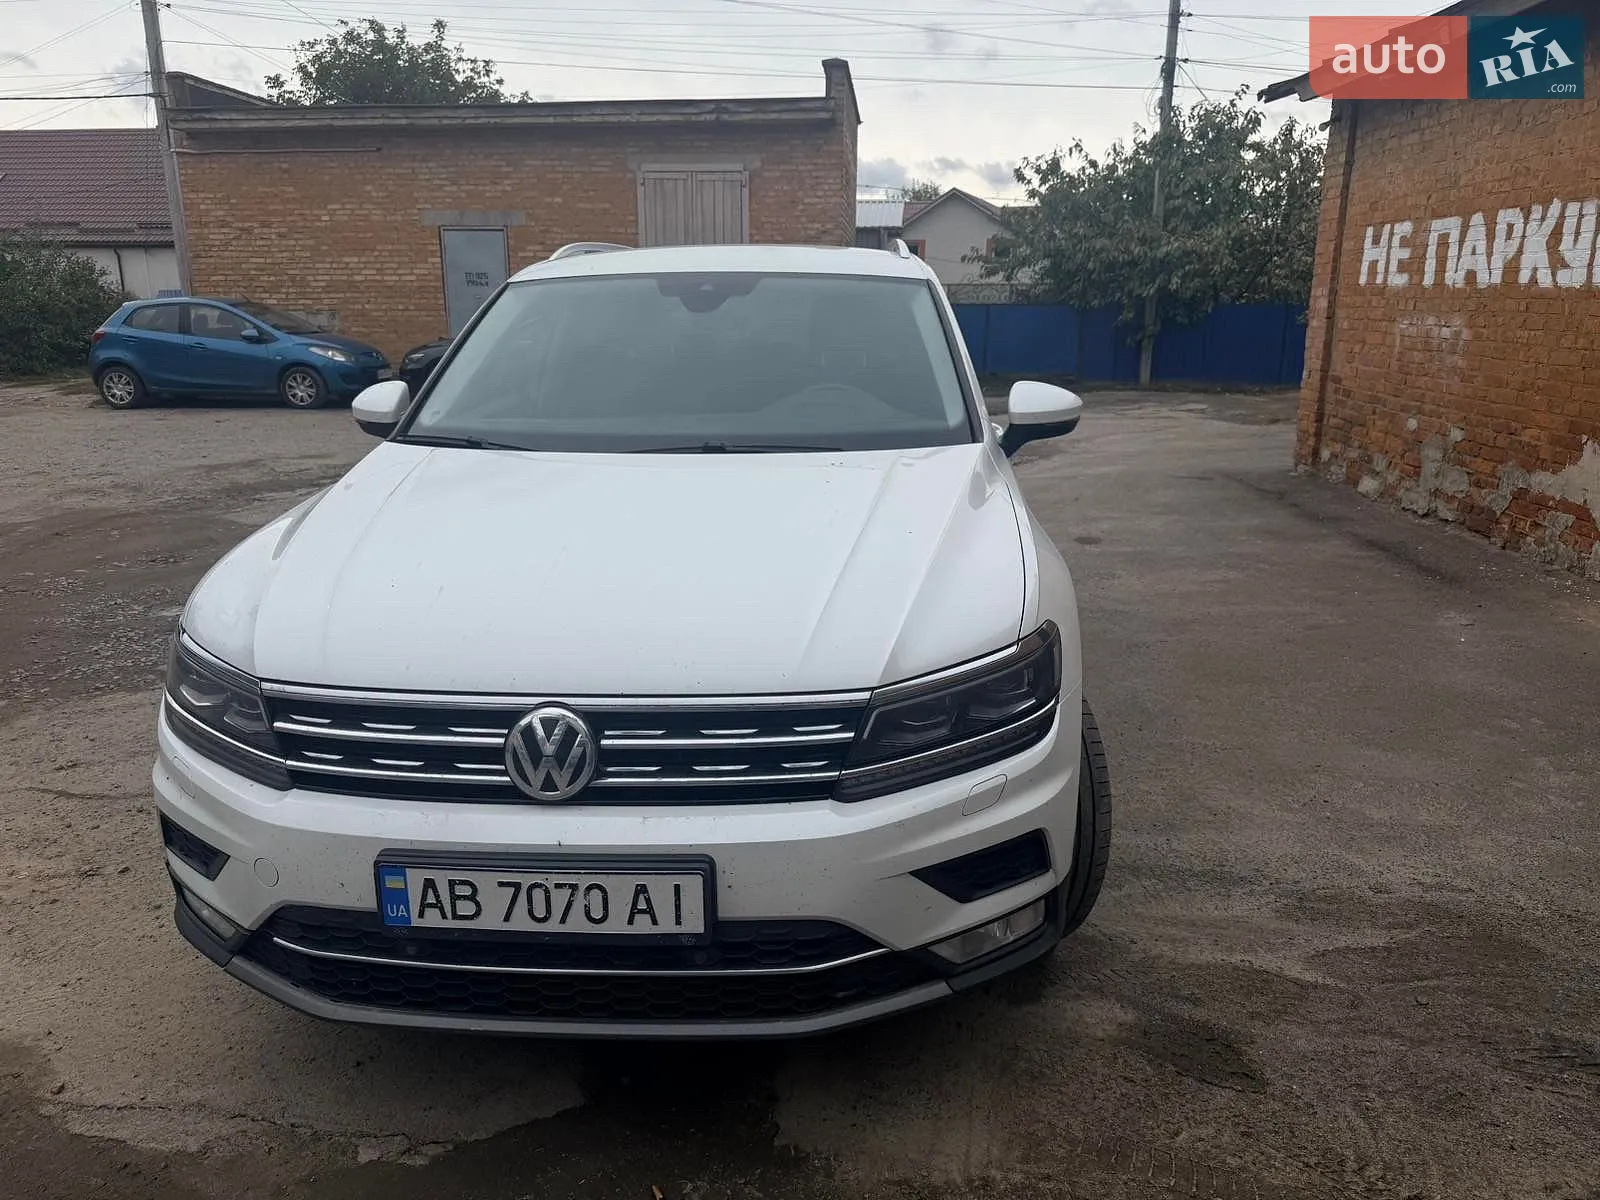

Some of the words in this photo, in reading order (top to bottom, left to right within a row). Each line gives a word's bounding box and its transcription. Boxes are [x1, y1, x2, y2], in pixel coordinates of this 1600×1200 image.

[1358, 220, 1413, 287] НЕ
[1422, 198, 1600, 289] ПАРКУ
[505, 707, 595, 800] VW
[387, 903, 409, 918] UA
[417, 877, 483, 921] AB
[497, 881, 609, 925] 7070
